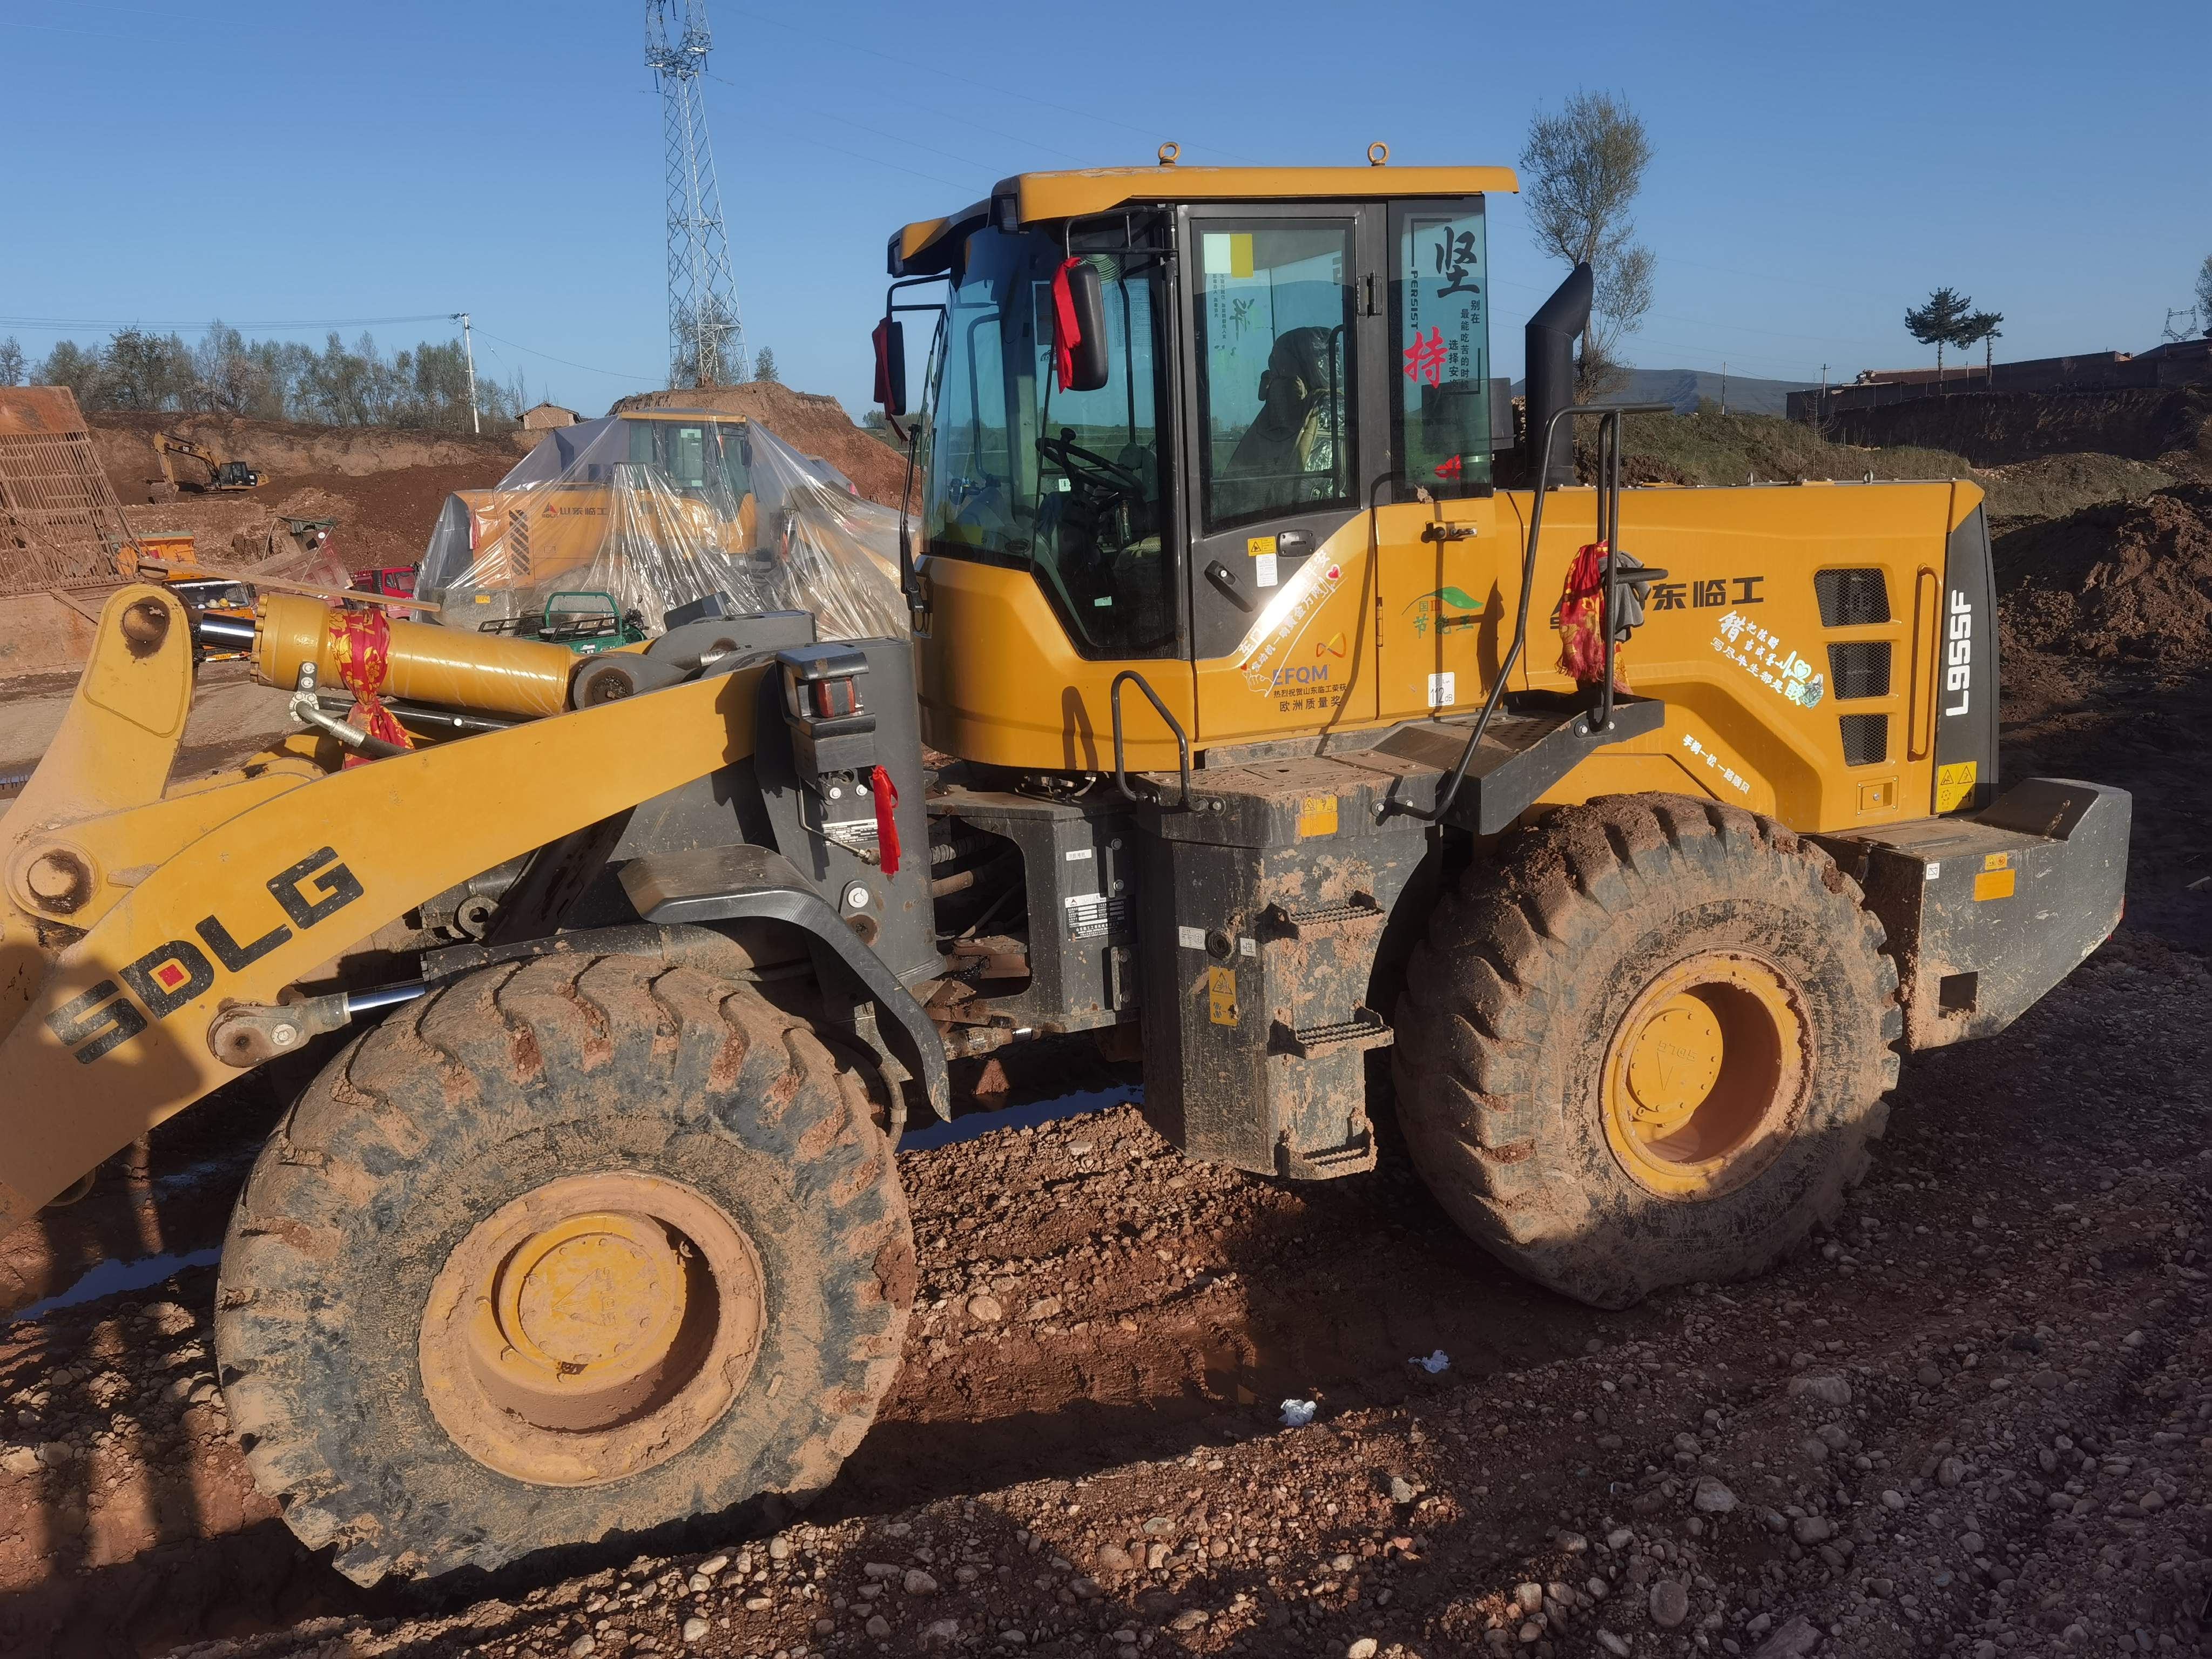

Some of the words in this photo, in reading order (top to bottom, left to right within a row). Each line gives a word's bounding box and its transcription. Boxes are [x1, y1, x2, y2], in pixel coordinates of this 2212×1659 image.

[1435, 226, 1480, 298] 坚
[1471, 300, 1480, 324] 别在
[1404, 326, 1448, 389] 持
[559, 507, 608, 515] 山东临工
[1652, 576, 1764, 611] 东临工
[1946, 590, 1972, 717] L955F
[1272, 664, 1328, 686] EFQM
[1273, 683, 1347, 699] 热烈祝贺山东临工荣获
[1431, 687, 1444, 704] 112
[1445, 694, 1453, 702] dB
[1280, 696, 1340, 712] 欧洲质量奖
[44, 846, 365, 1064] SDLG
